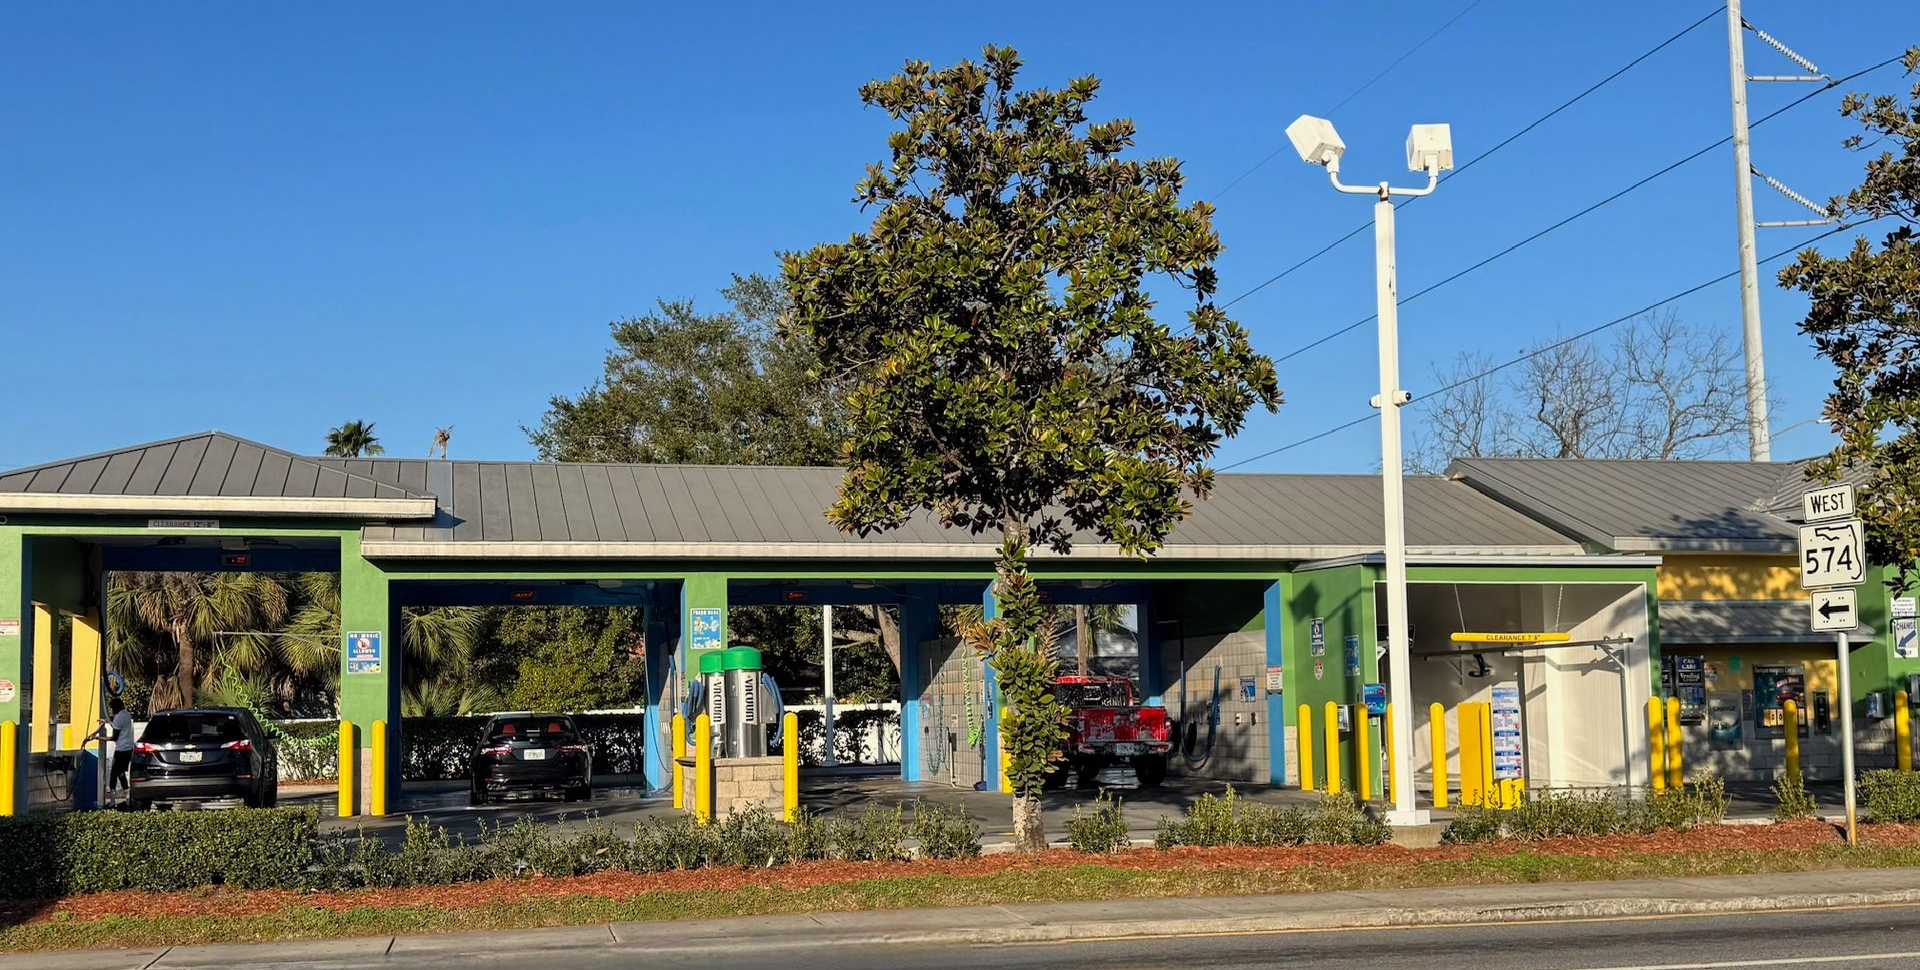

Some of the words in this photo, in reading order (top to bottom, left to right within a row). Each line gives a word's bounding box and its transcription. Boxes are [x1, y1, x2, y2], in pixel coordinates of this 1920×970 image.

[1810, 492, 1846, 514] WEST
[1806, 544, 1852, 575] 574
[1896, 621, 1917, 630] CHANGE
